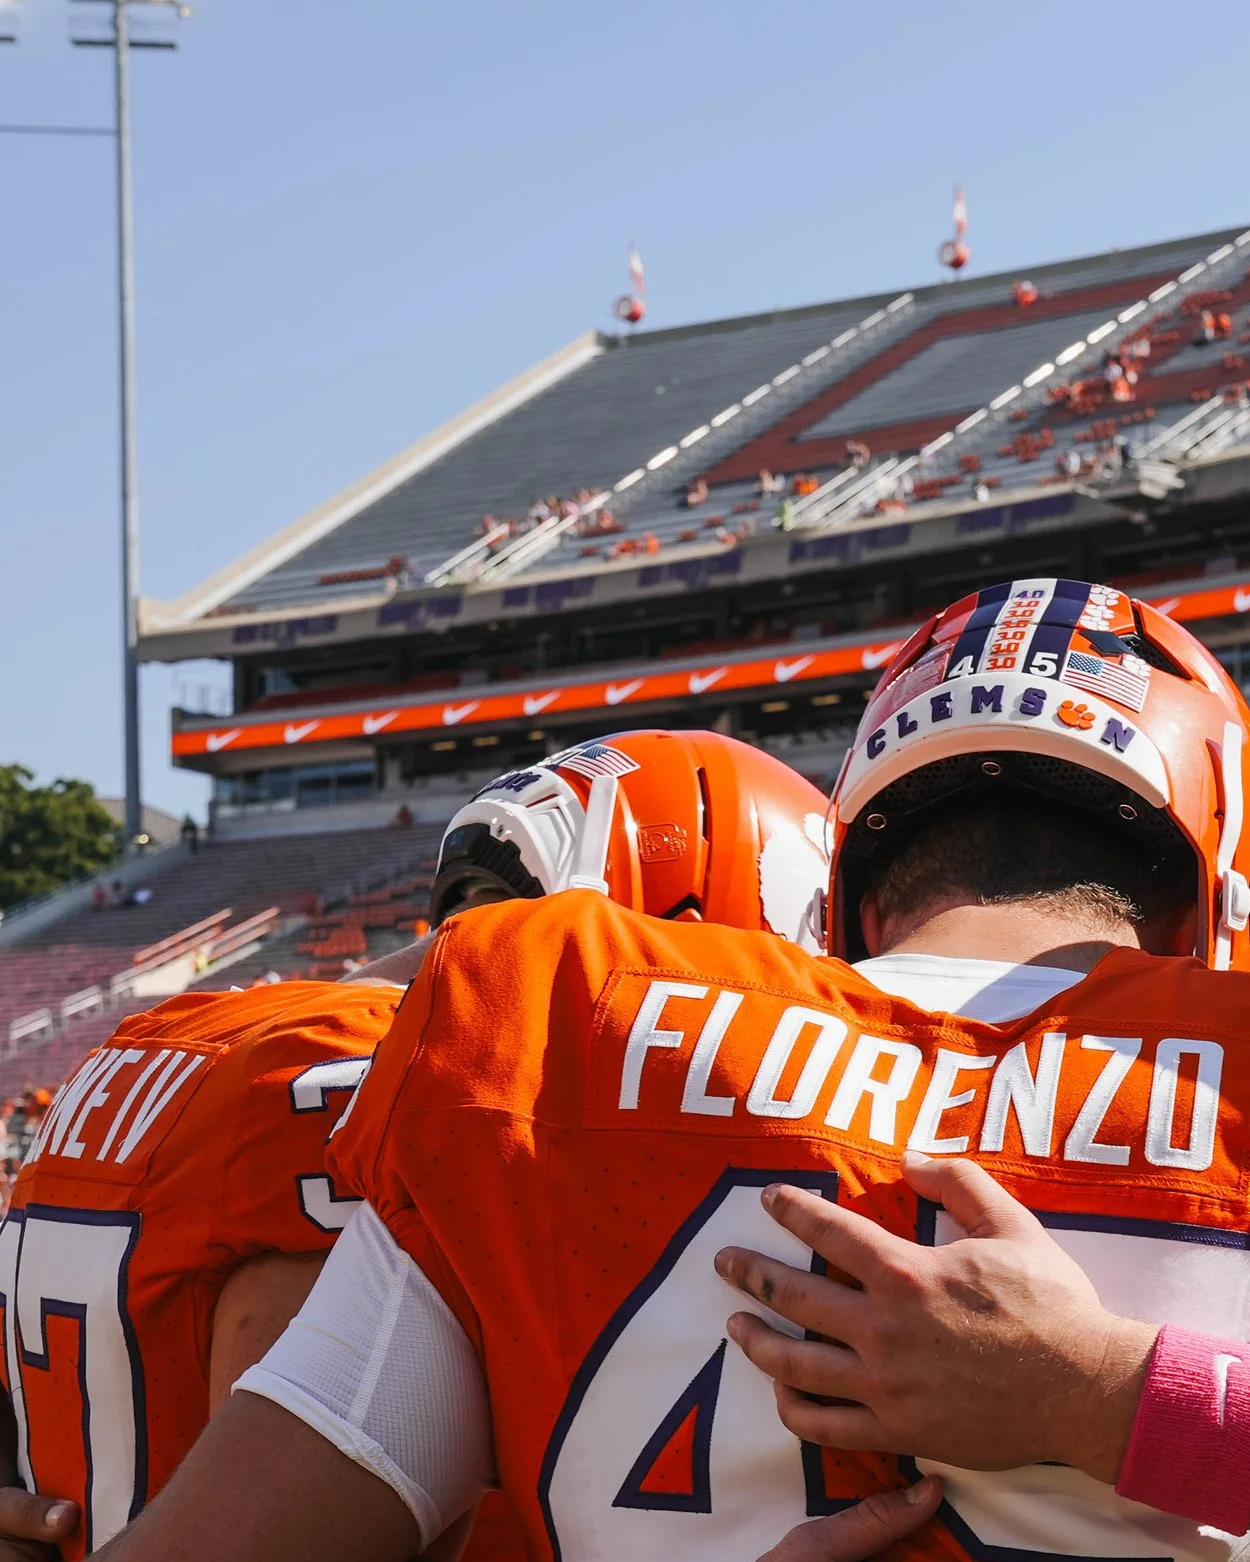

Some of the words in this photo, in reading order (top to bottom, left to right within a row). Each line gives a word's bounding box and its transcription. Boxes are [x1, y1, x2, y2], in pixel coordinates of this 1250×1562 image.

[948, 655, 974, 677] 4
[1029, 652, 1059, 677] 5
[985, 657, 1016, 670] 3.0
[866, 685, 1136, 760] CLEMSN
[617, 980, 1224, 1172] FLORENZO
